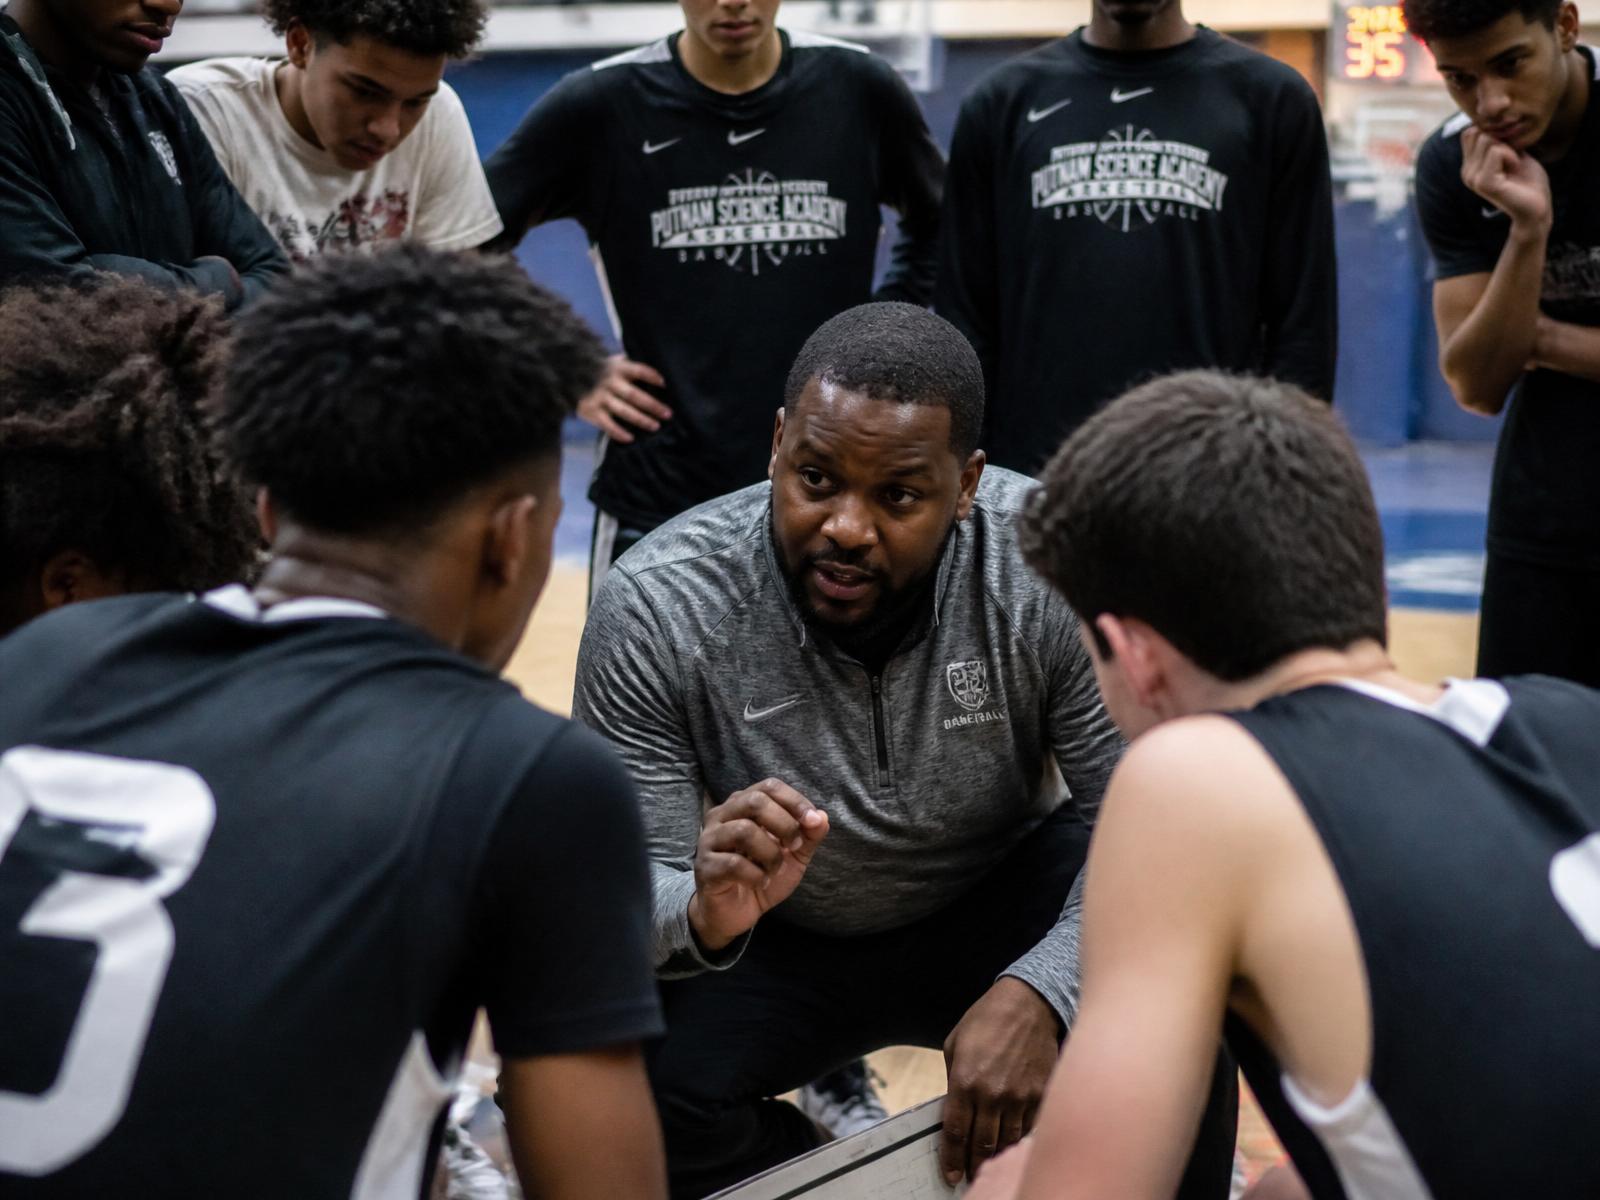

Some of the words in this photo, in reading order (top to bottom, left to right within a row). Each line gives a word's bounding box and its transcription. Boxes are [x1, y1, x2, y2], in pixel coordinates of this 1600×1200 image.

[1031, 157, 1092, 208] PUTNAM
[1094, 154, 1157, 178] SCIENCE
[1158, 154, 1228, 211] ACADEMY
[651, 199, 715, 247] PUTNAM
[717, 195, 781, 224] SCIENCE
[783, 194, 847, 237] ACADEMY
